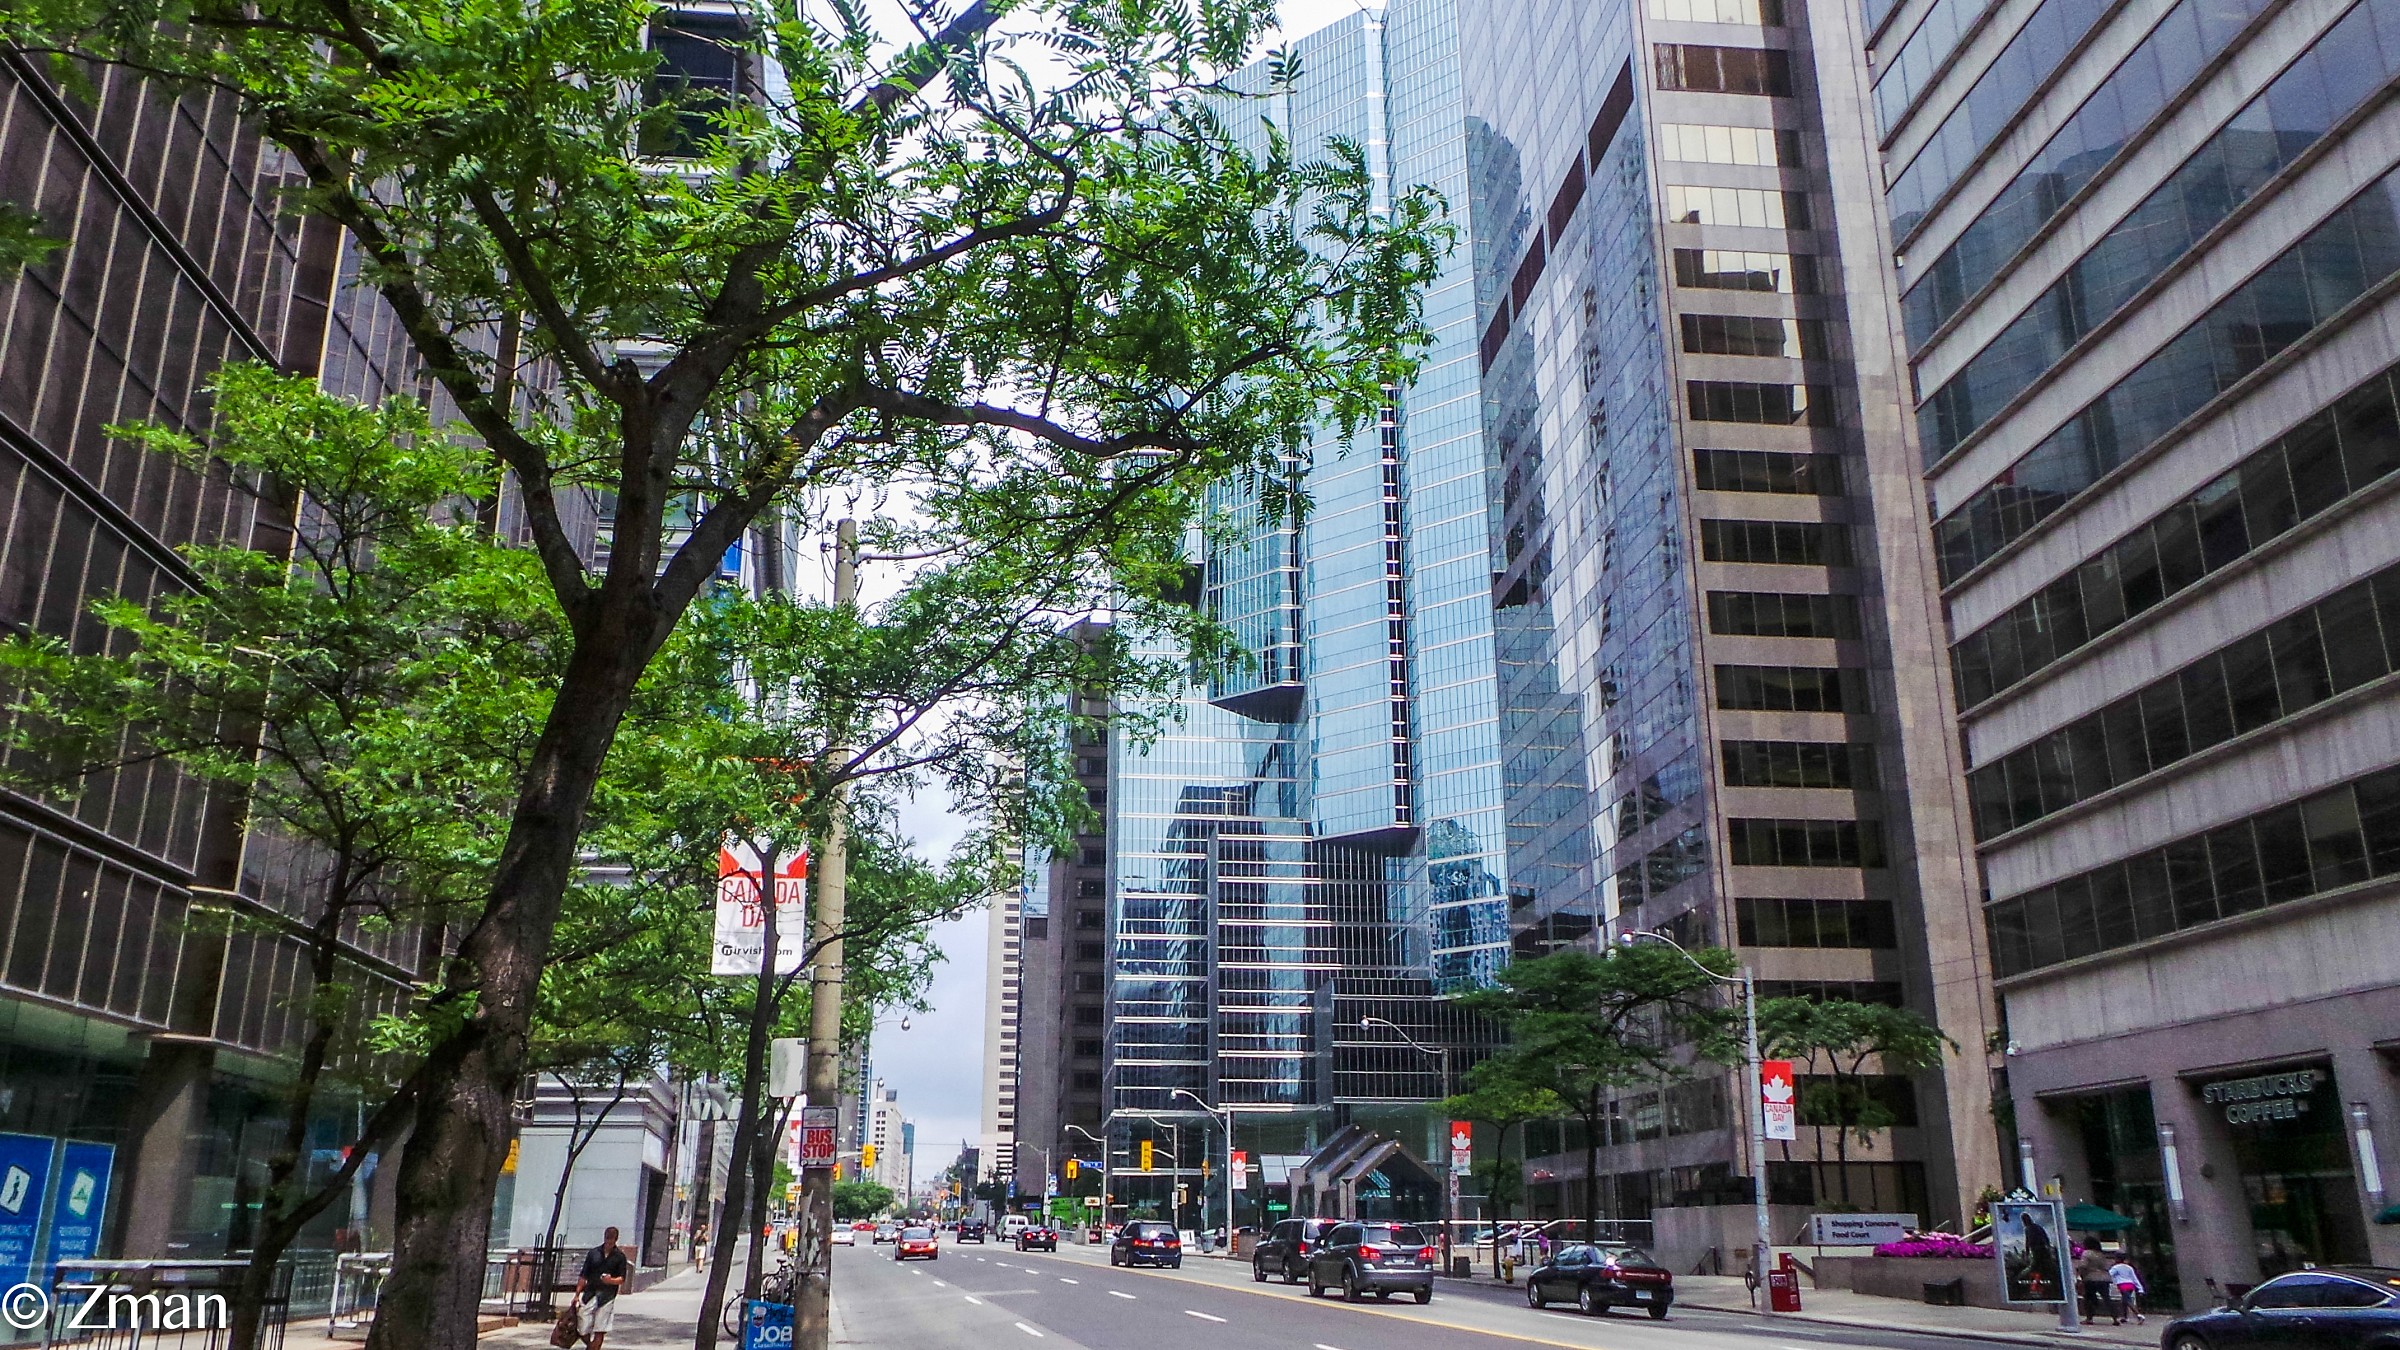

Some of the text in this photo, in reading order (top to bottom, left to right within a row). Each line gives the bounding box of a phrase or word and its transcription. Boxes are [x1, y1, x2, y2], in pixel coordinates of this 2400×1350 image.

[721, 880, 801, 904] CANDA
[742, 904, 765, 928] DA
[2203, 1071, 2313, 1103] STARBUCKS
[1765, 1104, 1792, 1114] CANADA
[1772, 1113, 1785, 1122] DAY
[2226, 1098, 2296, 1124] COFFEE
[806, 1129, 832, 1144] BUS
[802, 1143, 834, 1159] STOP
